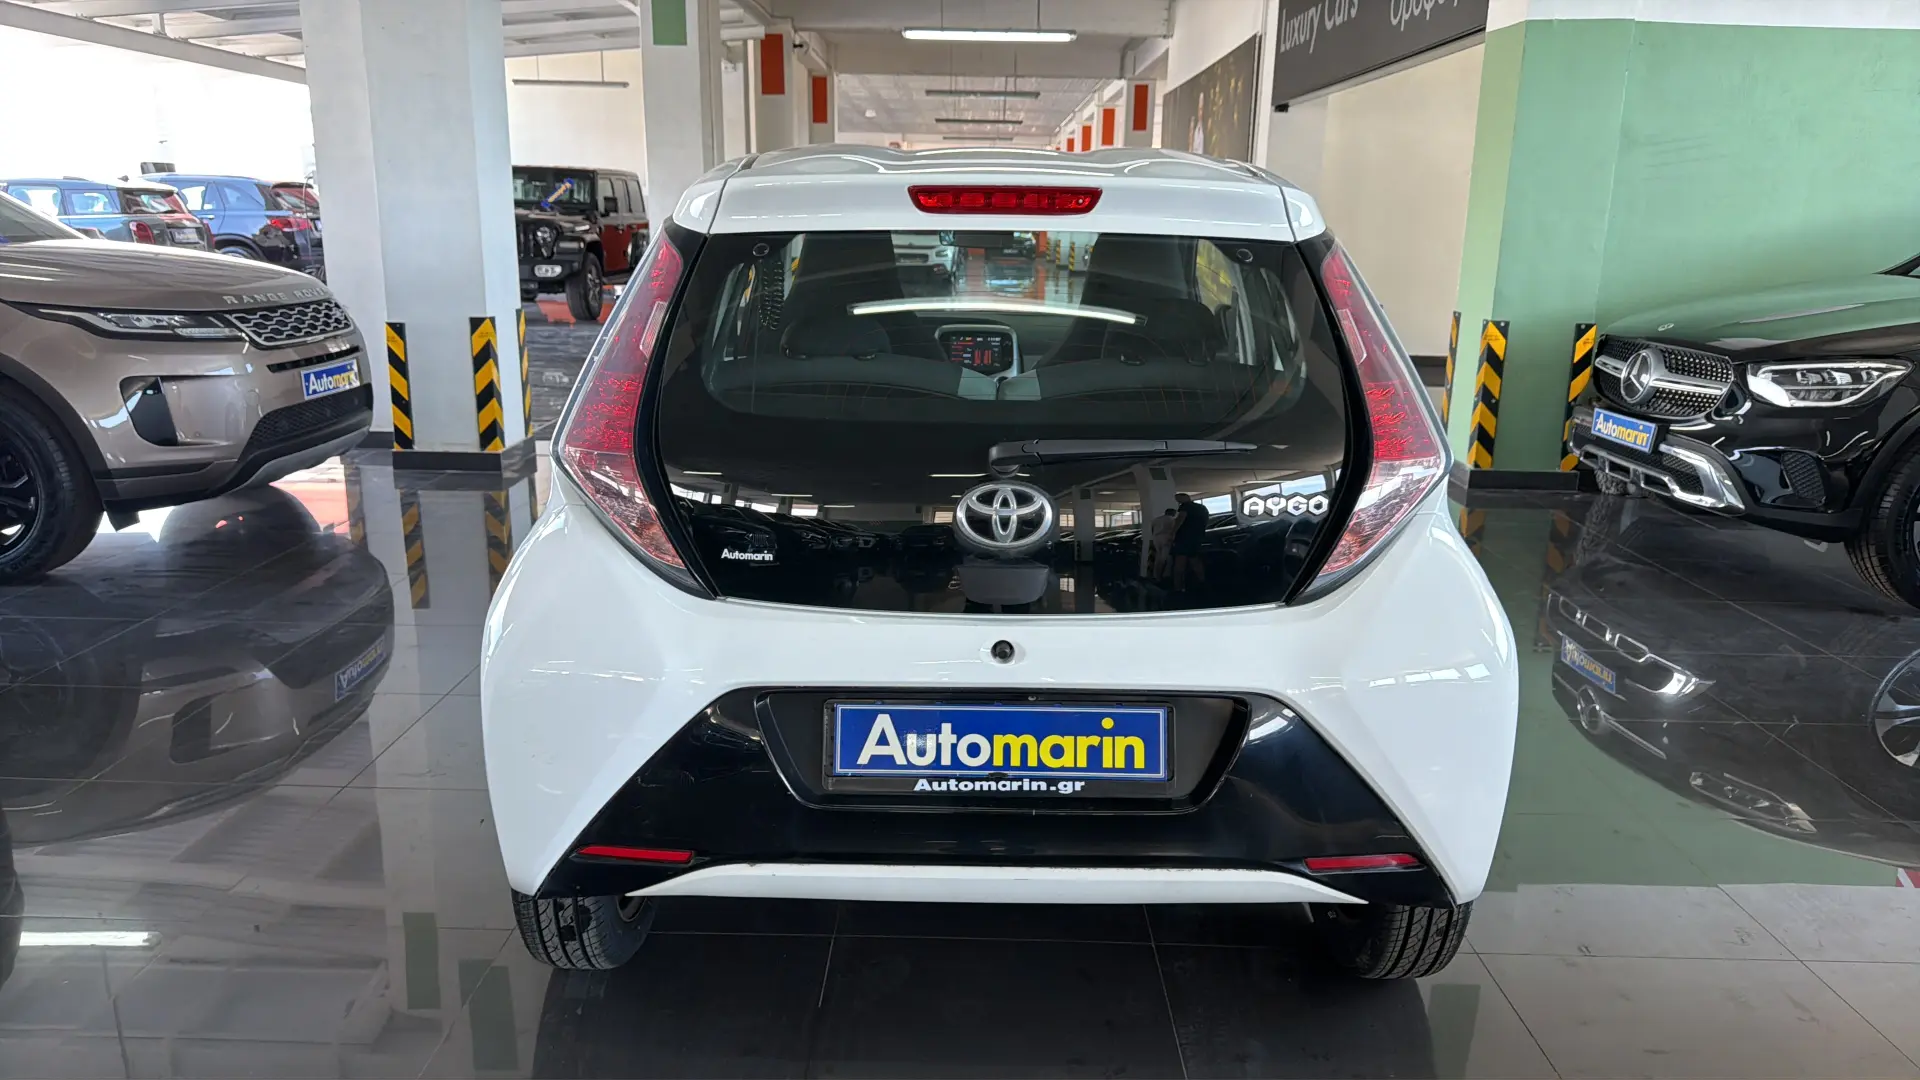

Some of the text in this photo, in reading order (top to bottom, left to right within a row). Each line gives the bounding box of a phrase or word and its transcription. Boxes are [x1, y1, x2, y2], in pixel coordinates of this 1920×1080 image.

[1280, 3, 1322, 54] Luxury
[1595, 412, 1648, 447] Automarin
[1243, 495, 1329, 517] AYGO
[721, 548, 773, 561] Automarin
[856, 713, 1145, 769] Automarin
[913, 778, 1086, 794] Automarin.gr
